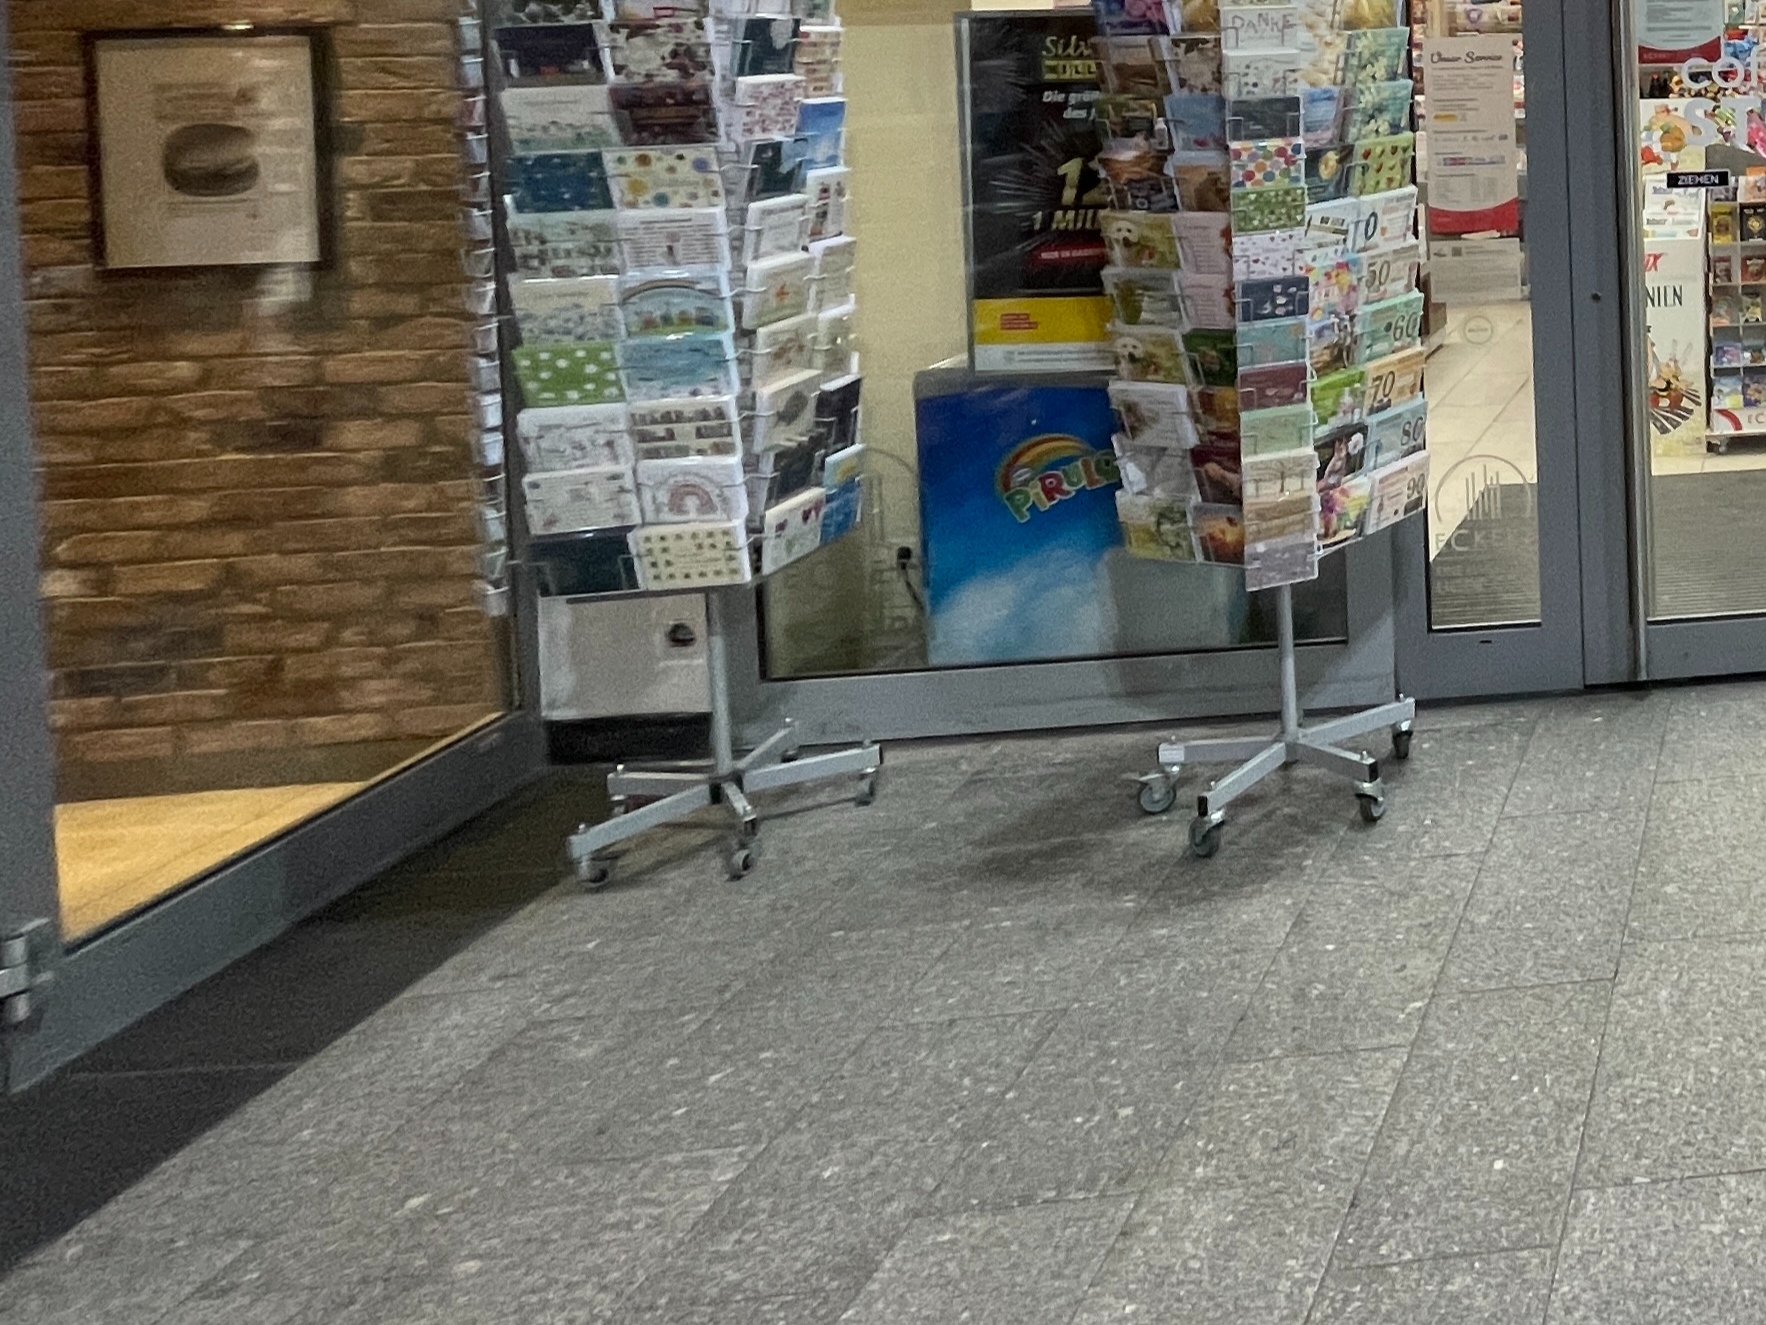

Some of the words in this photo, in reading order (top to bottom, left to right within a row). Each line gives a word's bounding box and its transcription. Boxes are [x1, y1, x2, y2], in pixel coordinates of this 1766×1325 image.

[1230, 12, 1297, 34] DANKE
[1041, 34, 1094, 57] Silv
[1677, 173, 1720, 186] ZIEHEN
[1364, 260, 1391, 289] 50
[1391, 312, 1418, 342] 60
[1371, 369, 1396, 402] 70
[1406, 472, 1426, 502] 90
[1434, 528, 1536, 553] ECKE
